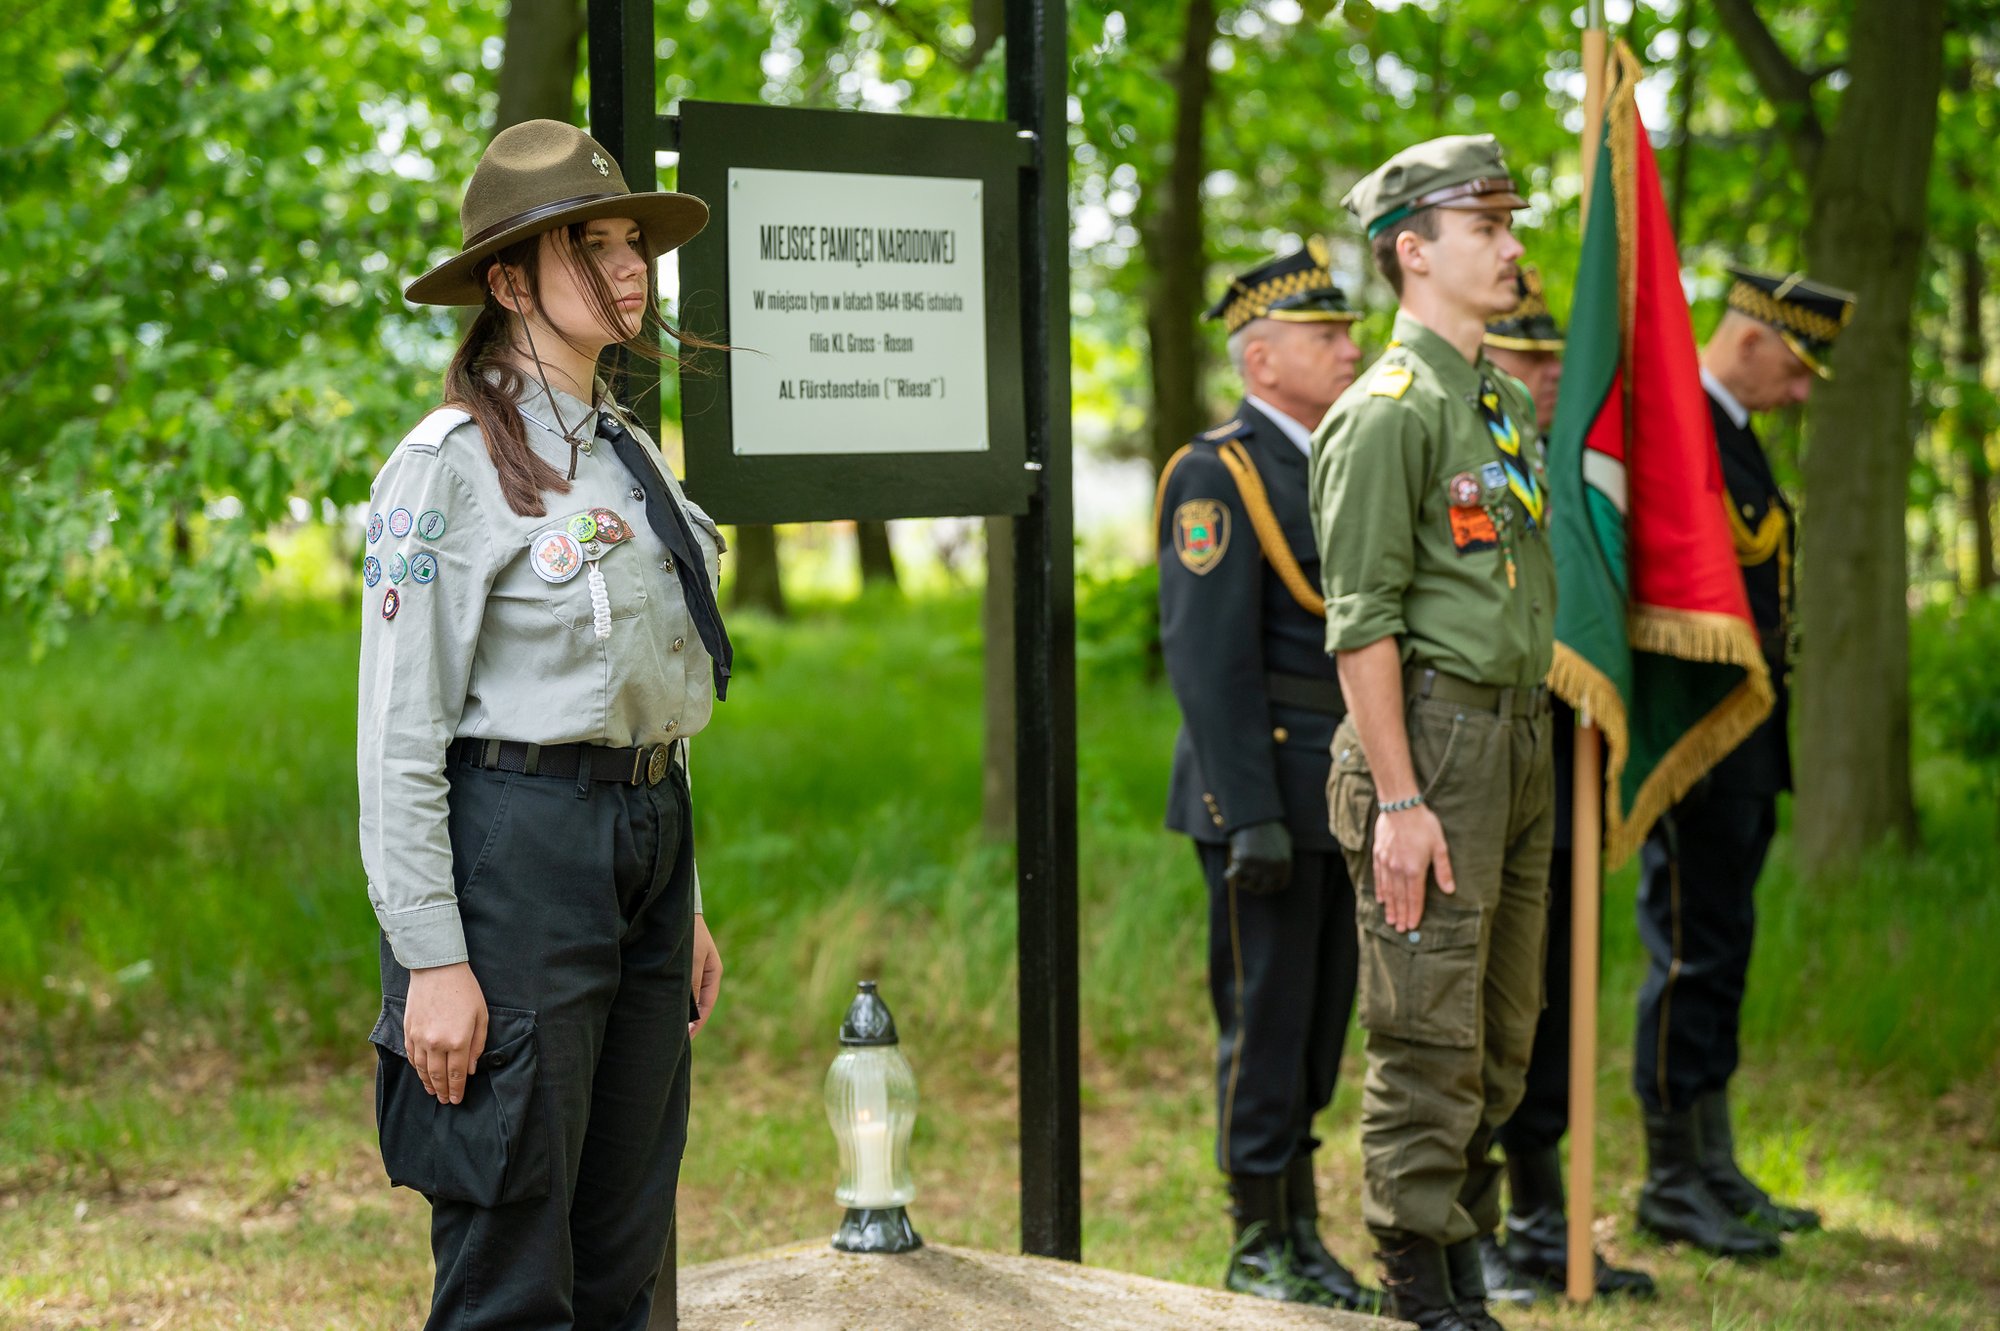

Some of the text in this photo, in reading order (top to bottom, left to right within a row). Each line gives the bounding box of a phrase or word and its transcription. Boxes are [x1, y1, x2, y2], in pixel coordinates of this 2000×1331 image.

[760, 224, 956, 268] MIEJSCE PAMIĘCI NARODOWEJ
[754, 290, 764, 310] W
[768, 291, 807, 312] miejscu
[810, 292, 829, 314] tym
[832, 296, 841, 311] w
[843, 292, 873, 312] latach
[810, 334, 829, 353] filia
[832, 334, 845, 353] KL
[848, 334, 875, 353] Gross
[779, 380, 795, 400] AL
[800, 380, 880, 400] Fürstenstein
